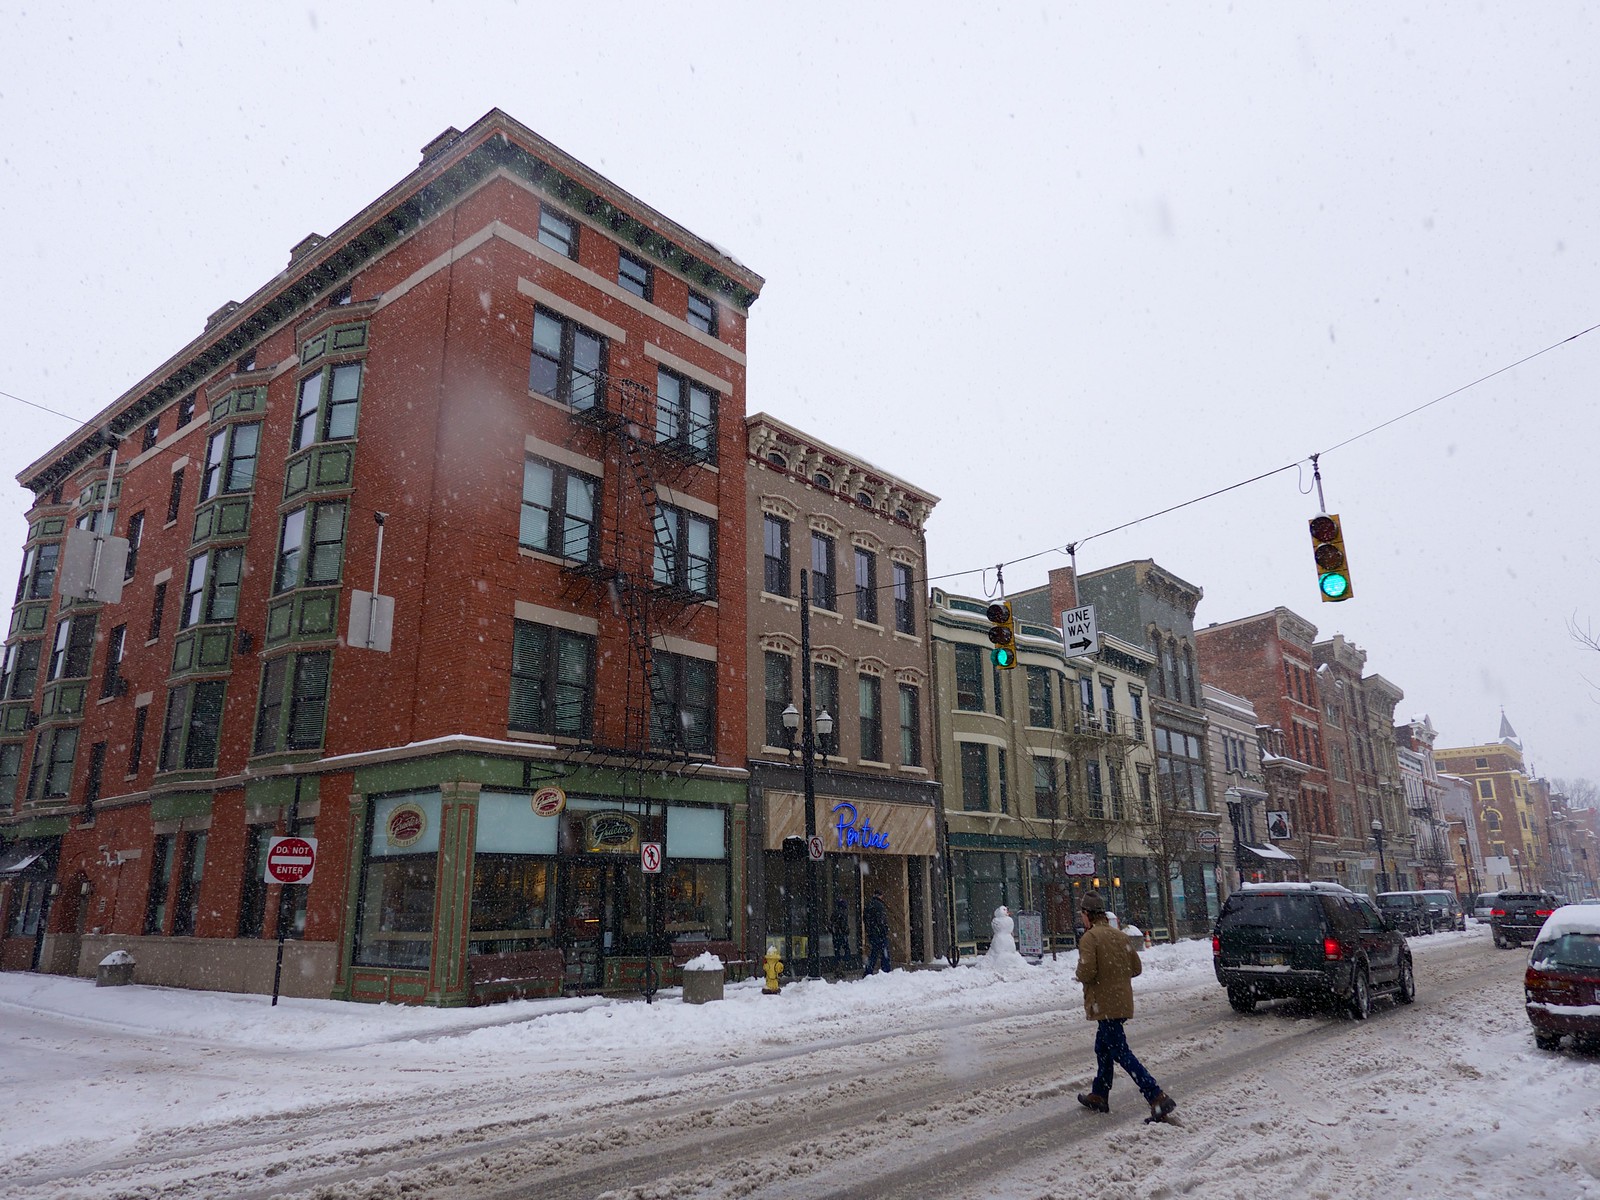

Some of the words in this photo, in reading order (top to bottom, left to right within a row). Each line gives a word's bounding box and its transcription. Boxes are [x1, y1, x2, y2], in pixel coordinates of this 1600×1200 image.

[1067, 609, 1090, 624] ONE
[1067, 622, 1091, 637] WAY
[832, 802, 889, 849] Pontiac
[276, 846, 288, 854] DO
[292, 846, 309, 855] NOT
[276, 866, 304, 875] ENTER
